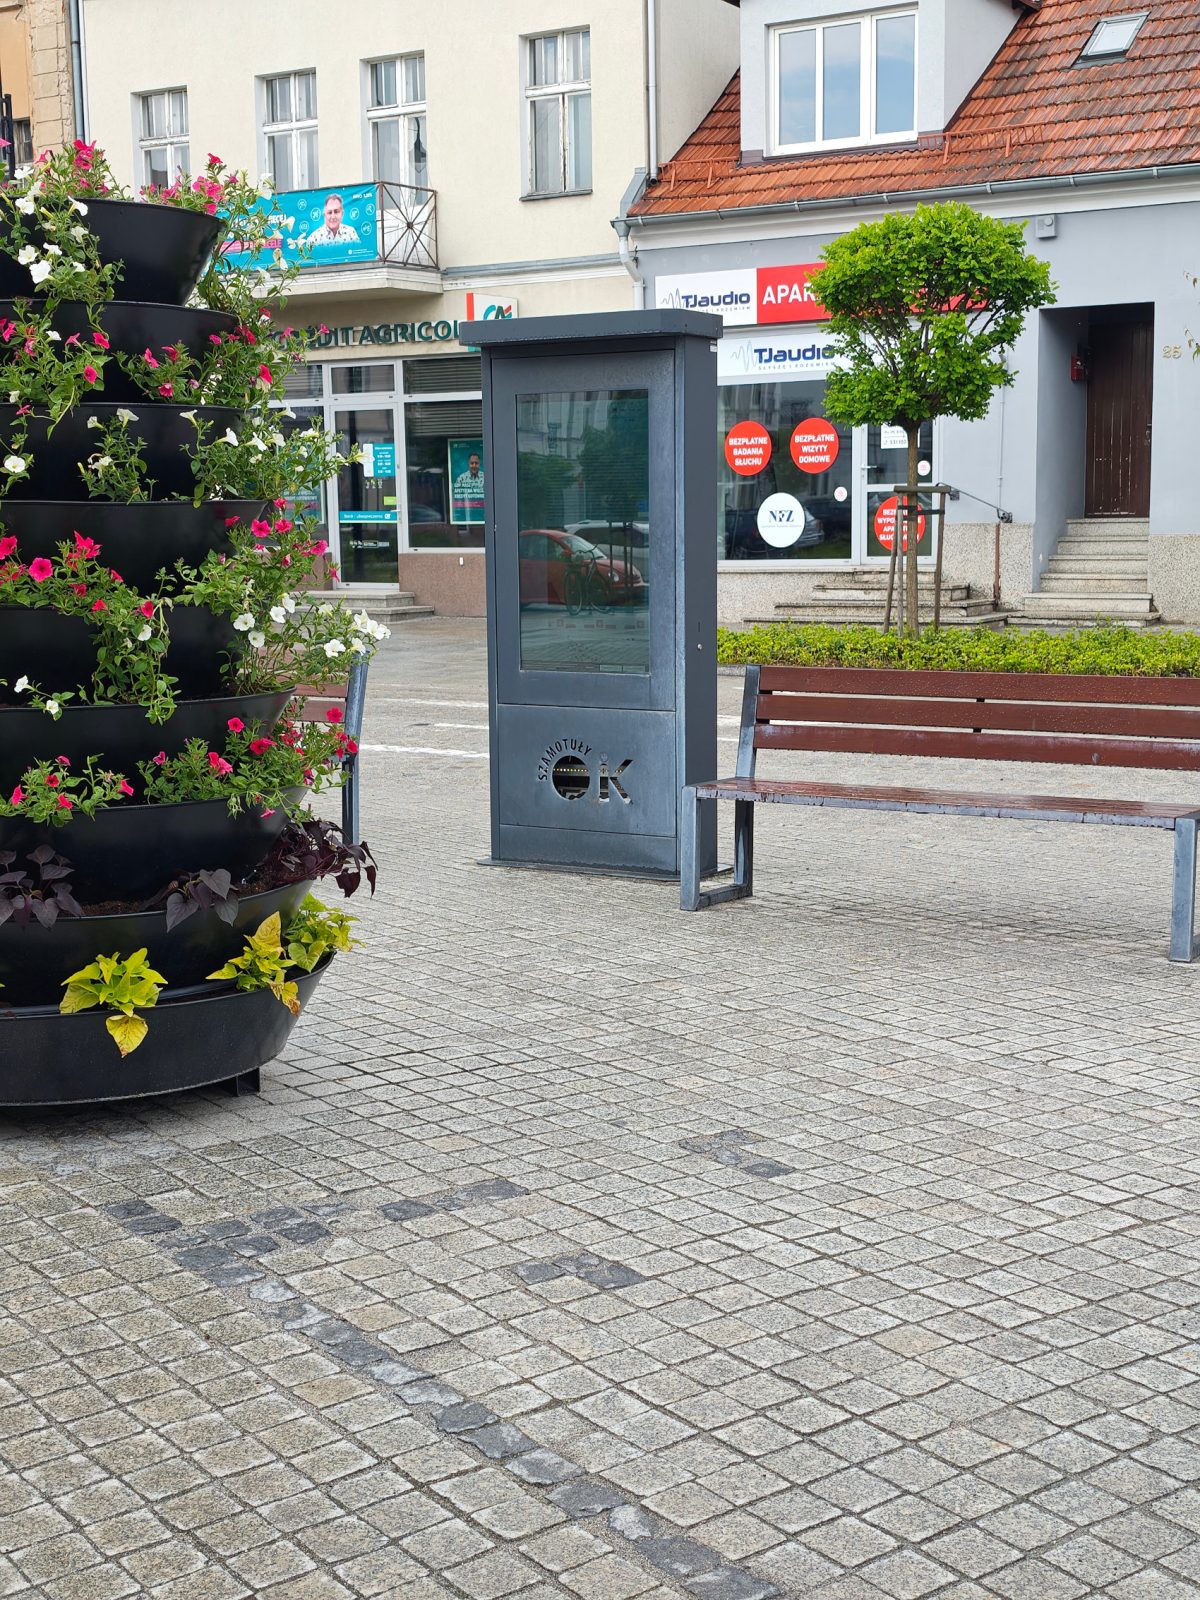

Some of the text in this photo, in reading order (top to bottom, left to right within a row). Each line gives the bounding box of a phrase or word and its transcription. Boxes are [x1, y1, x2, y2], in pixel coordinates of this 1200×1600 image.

[762, 282, 821, 305] APAR
[681, 291, 751, 308] TJaudio
[754, 344, 836, 364] TJaudio
[729, 437, 768, 446] BEZPŁATNE
[794, 434, 835, 443] BEZPŁATNE
[733, 447, 763, 456] BADANIA
[801, 445, 828, 453] WIZYTY
[735, 458, 762, 466] SŁUCHU
[798, 455, 831, 464] DOMOWE
[769, 510, 794, 522] NFZ
[538, 738, 592, 781] SZAMOTUŁY
